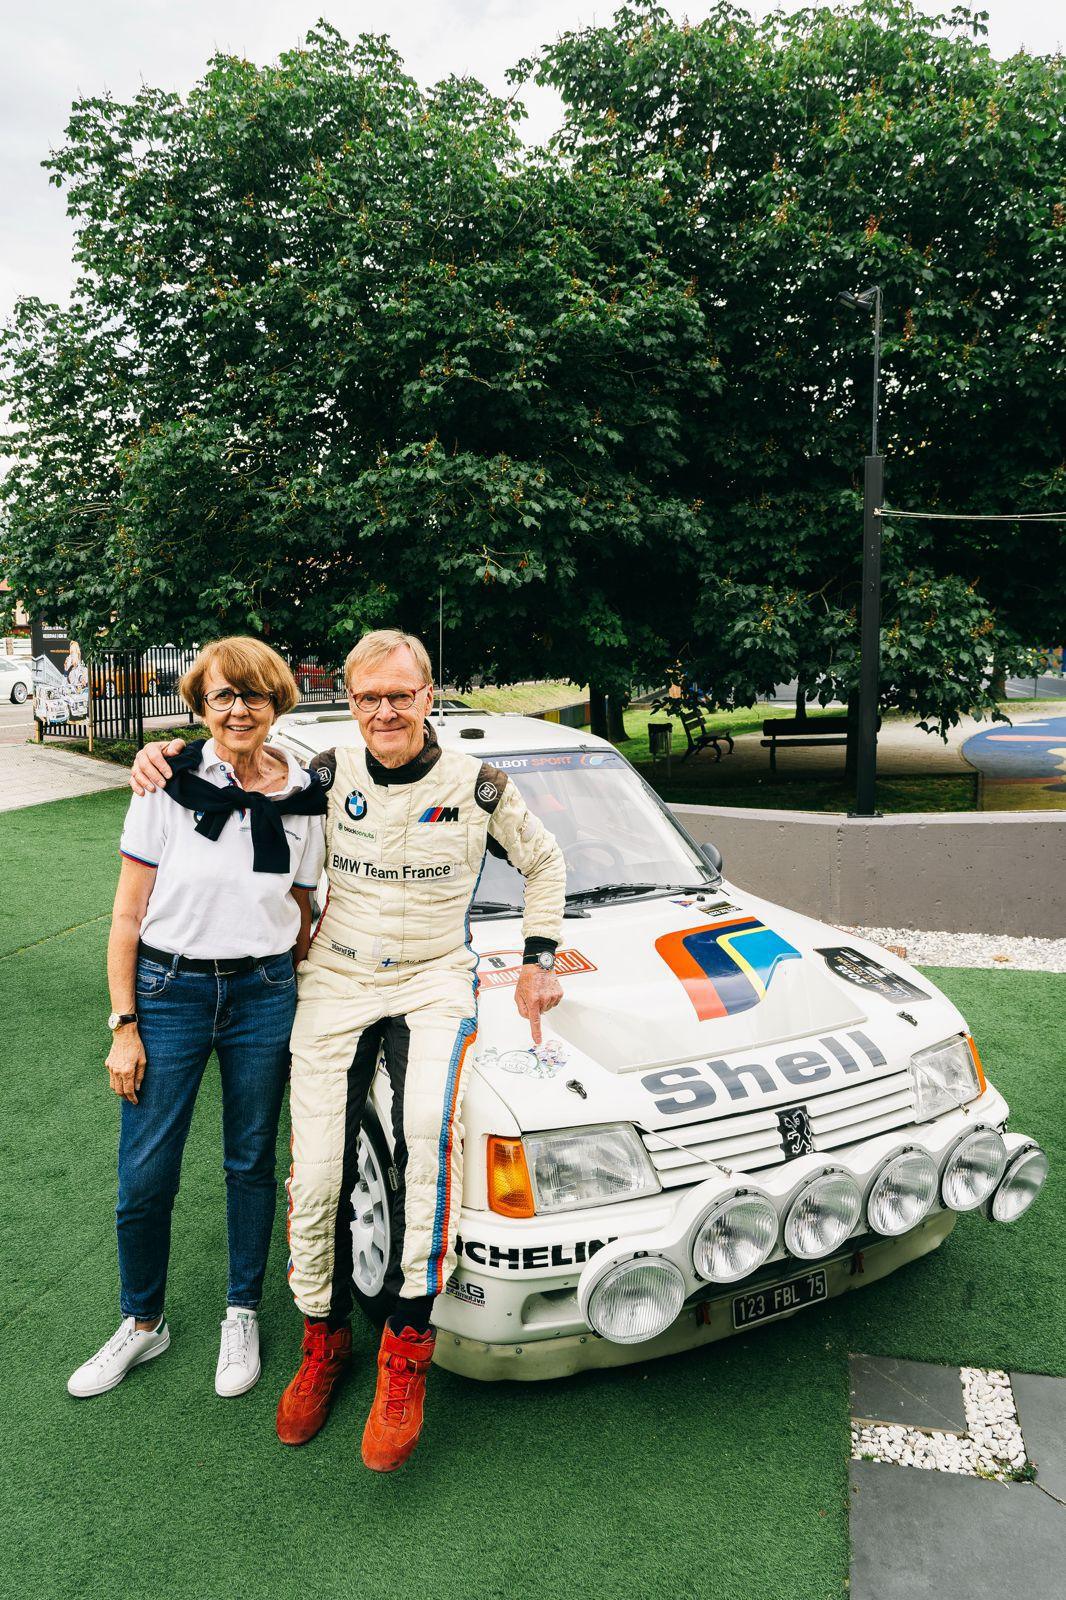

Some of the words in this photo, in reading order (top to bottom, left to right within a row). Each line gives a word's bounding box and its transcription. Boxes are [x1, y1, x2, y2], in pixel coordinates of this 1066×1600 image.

[488, 759, 528, 768] ALBOT
[531, 757, 572, 766] SPORT
[332, 854, 361, 874] BMW
[363, 863, 398, 879] Team
[402, 865, 451, 878] France
[486, 968, 522, 984] MON
[554, 952, 585, 972] RLO
[488, 957, 506, 968] 8
[640, 1030, 888, 1115] Shell
[454, 1235, 619, 1269] ICHELI
[740, 1295, 766, 1320] 123
[774, 1285, 800, 1309] FBL
[807, 1275, 824, 1298] 75
